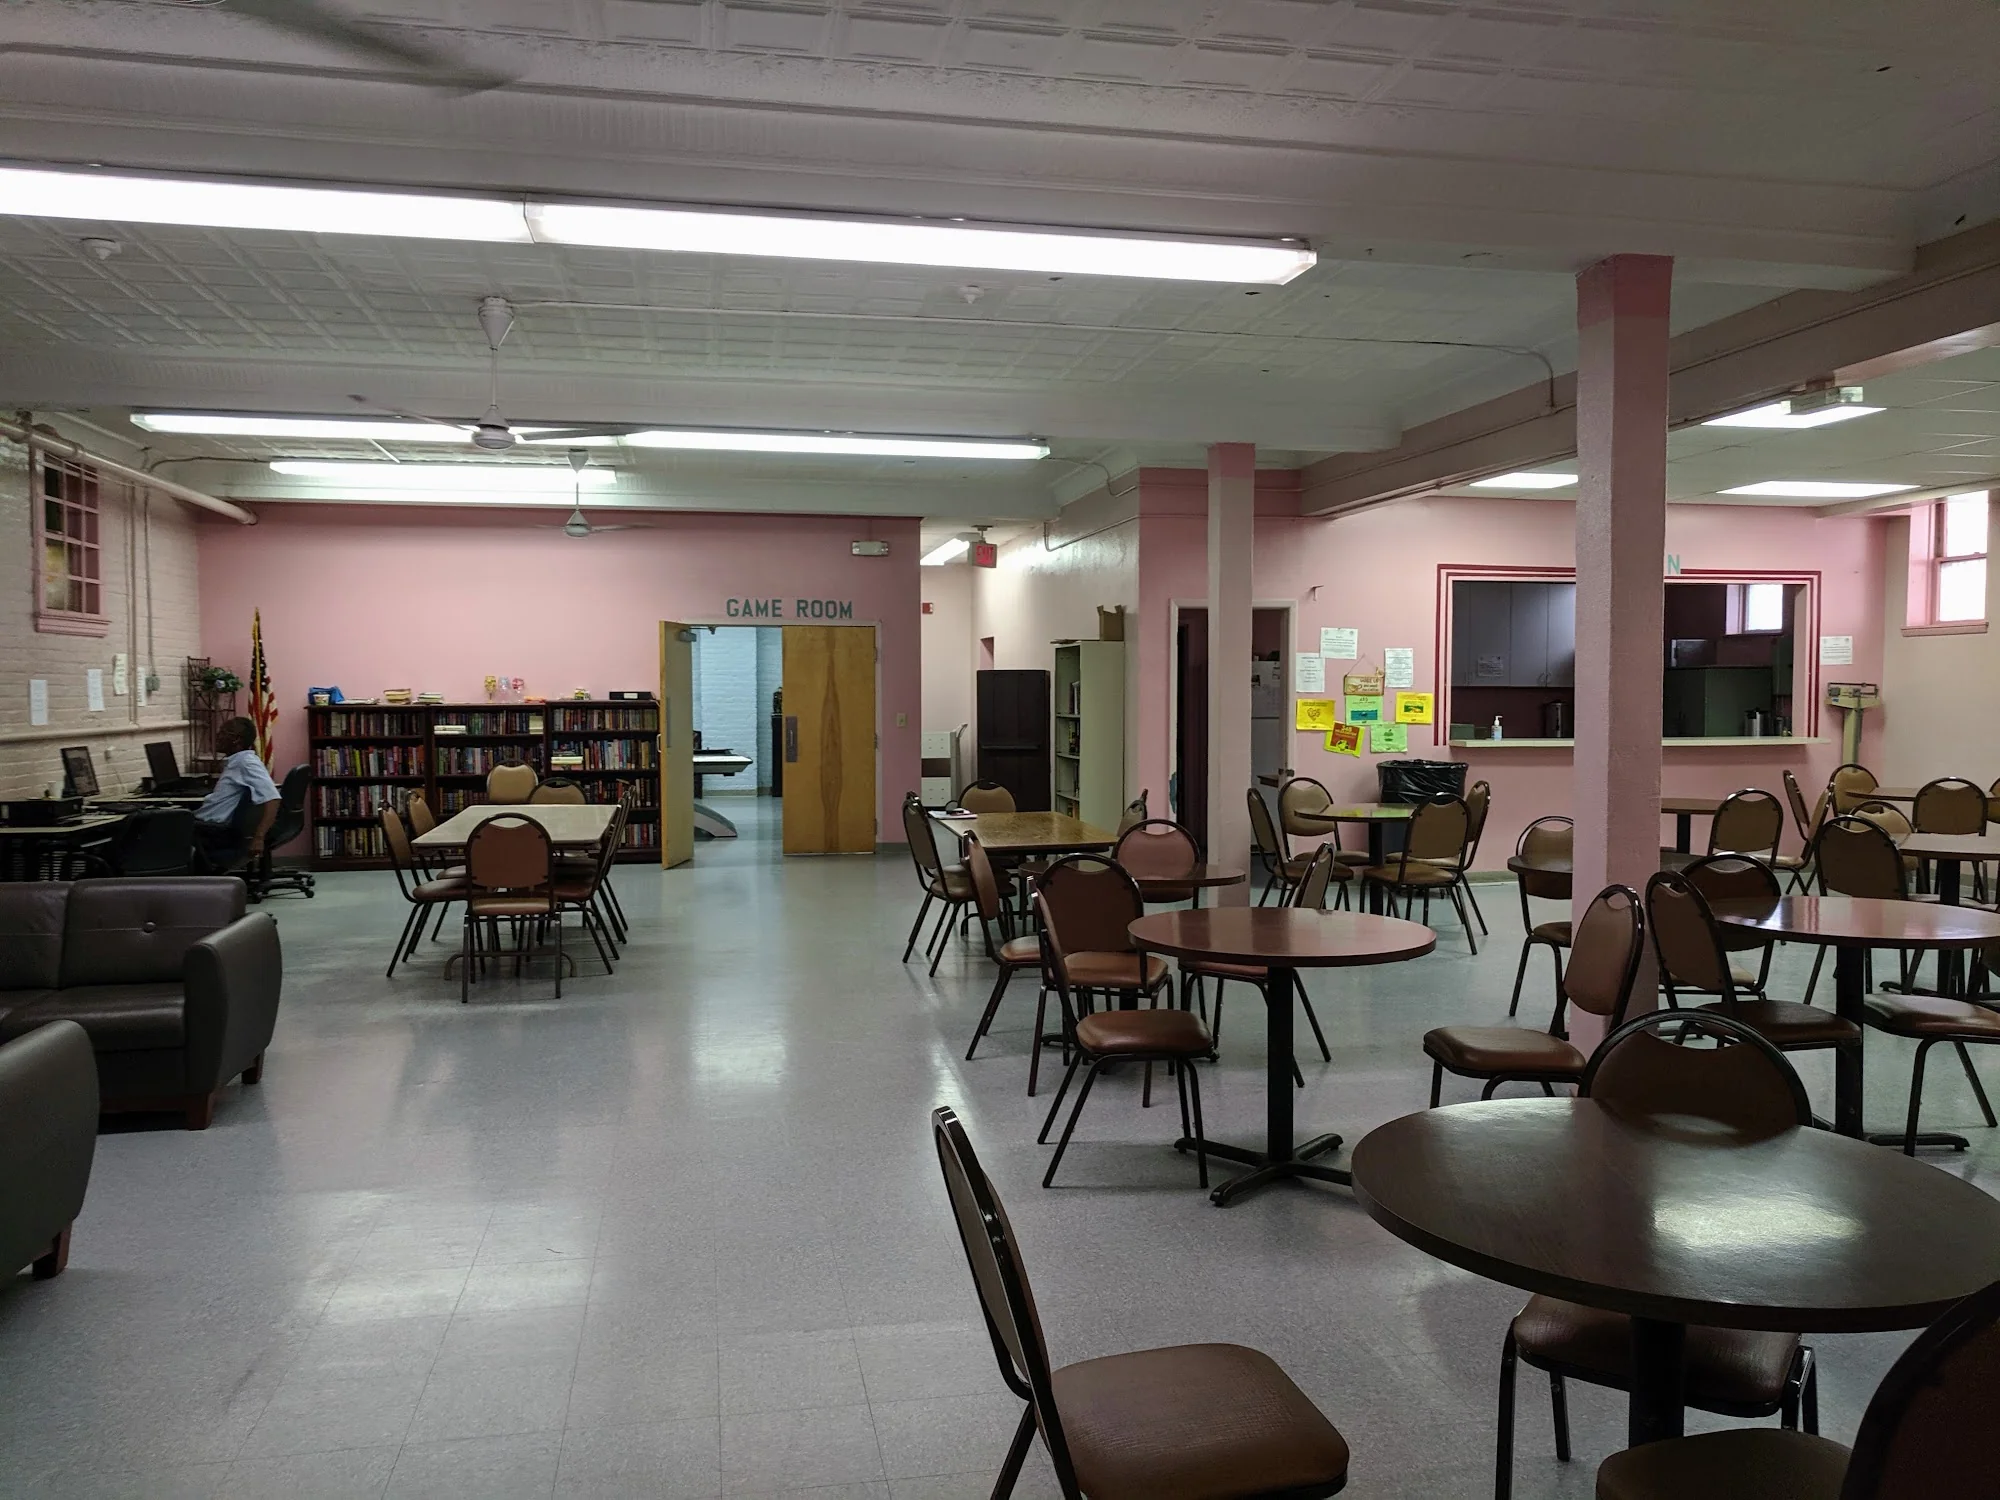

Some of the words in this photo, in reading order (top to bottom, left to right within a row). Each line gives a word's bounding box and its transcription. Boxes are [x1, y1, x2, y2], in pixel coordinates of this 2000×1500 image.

[975, 545, 994, 566] EXIT
[726, 598, 783, 618] GAME
[796, 599, 853, 619] ROOM
